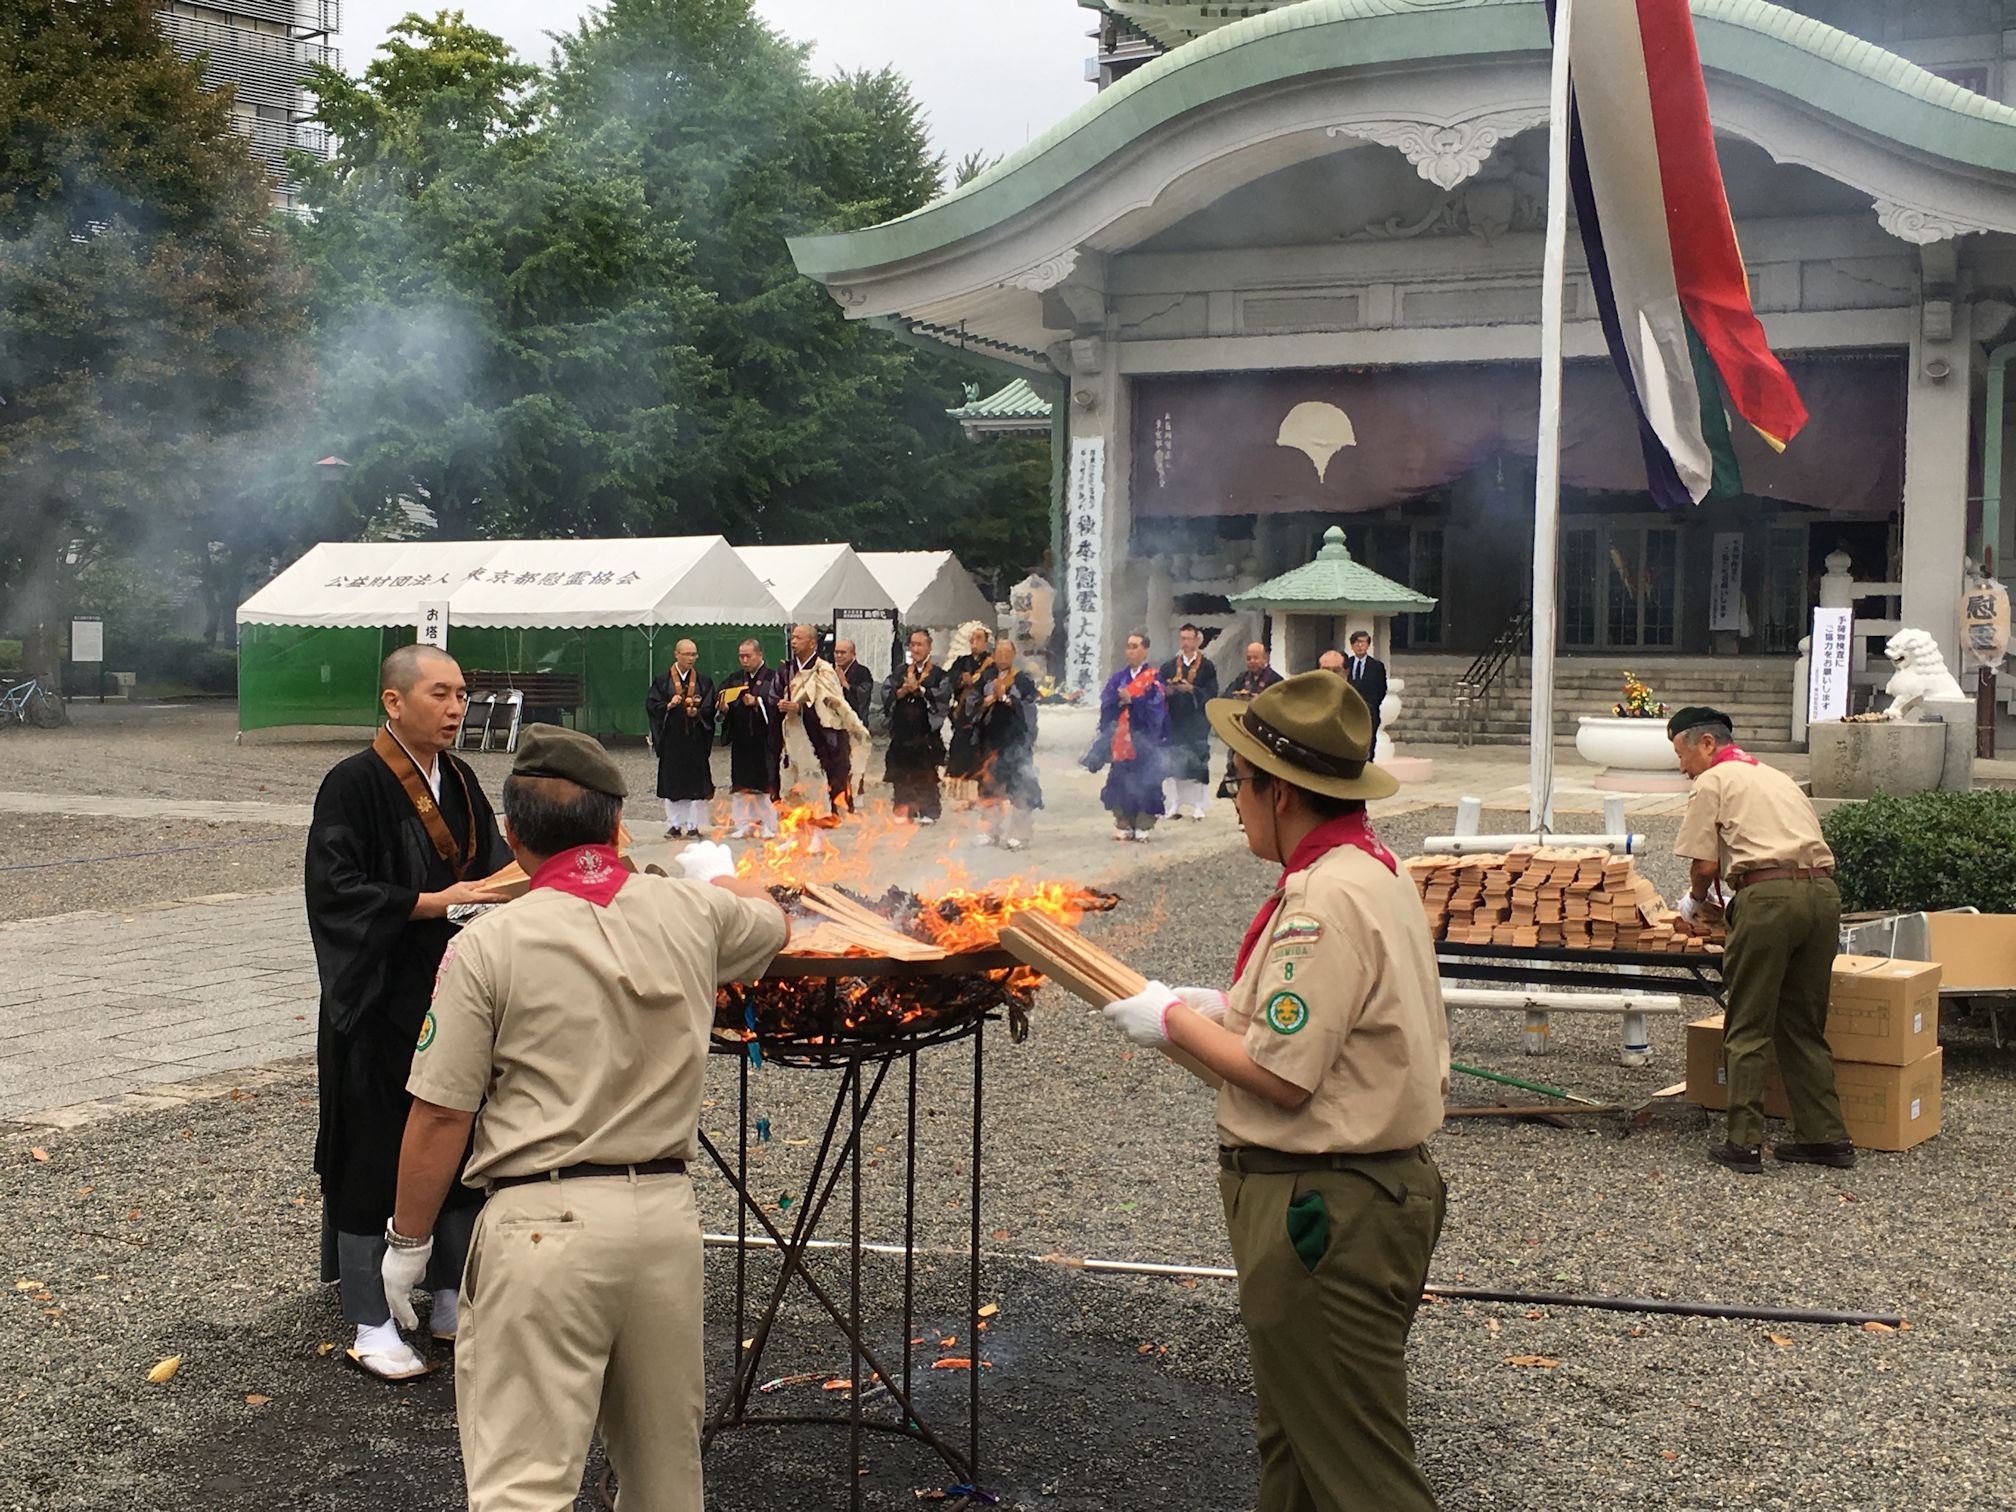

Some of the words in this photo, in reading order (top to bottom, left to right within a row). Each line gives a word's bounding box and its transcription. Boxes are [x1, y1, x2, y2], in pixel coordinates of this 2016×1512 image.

[324, 572, 450, 588] 公益財団法人
[460, 565, 642, 587] 東京都慰霊協会
[425, 608, 439, 647] お塔
[1835, 615, 1847, 668] 手荷物検査に
[1822, 624, 1834, 710] ご協力をお願いします
[1285, 962, 1294, 980] 8
